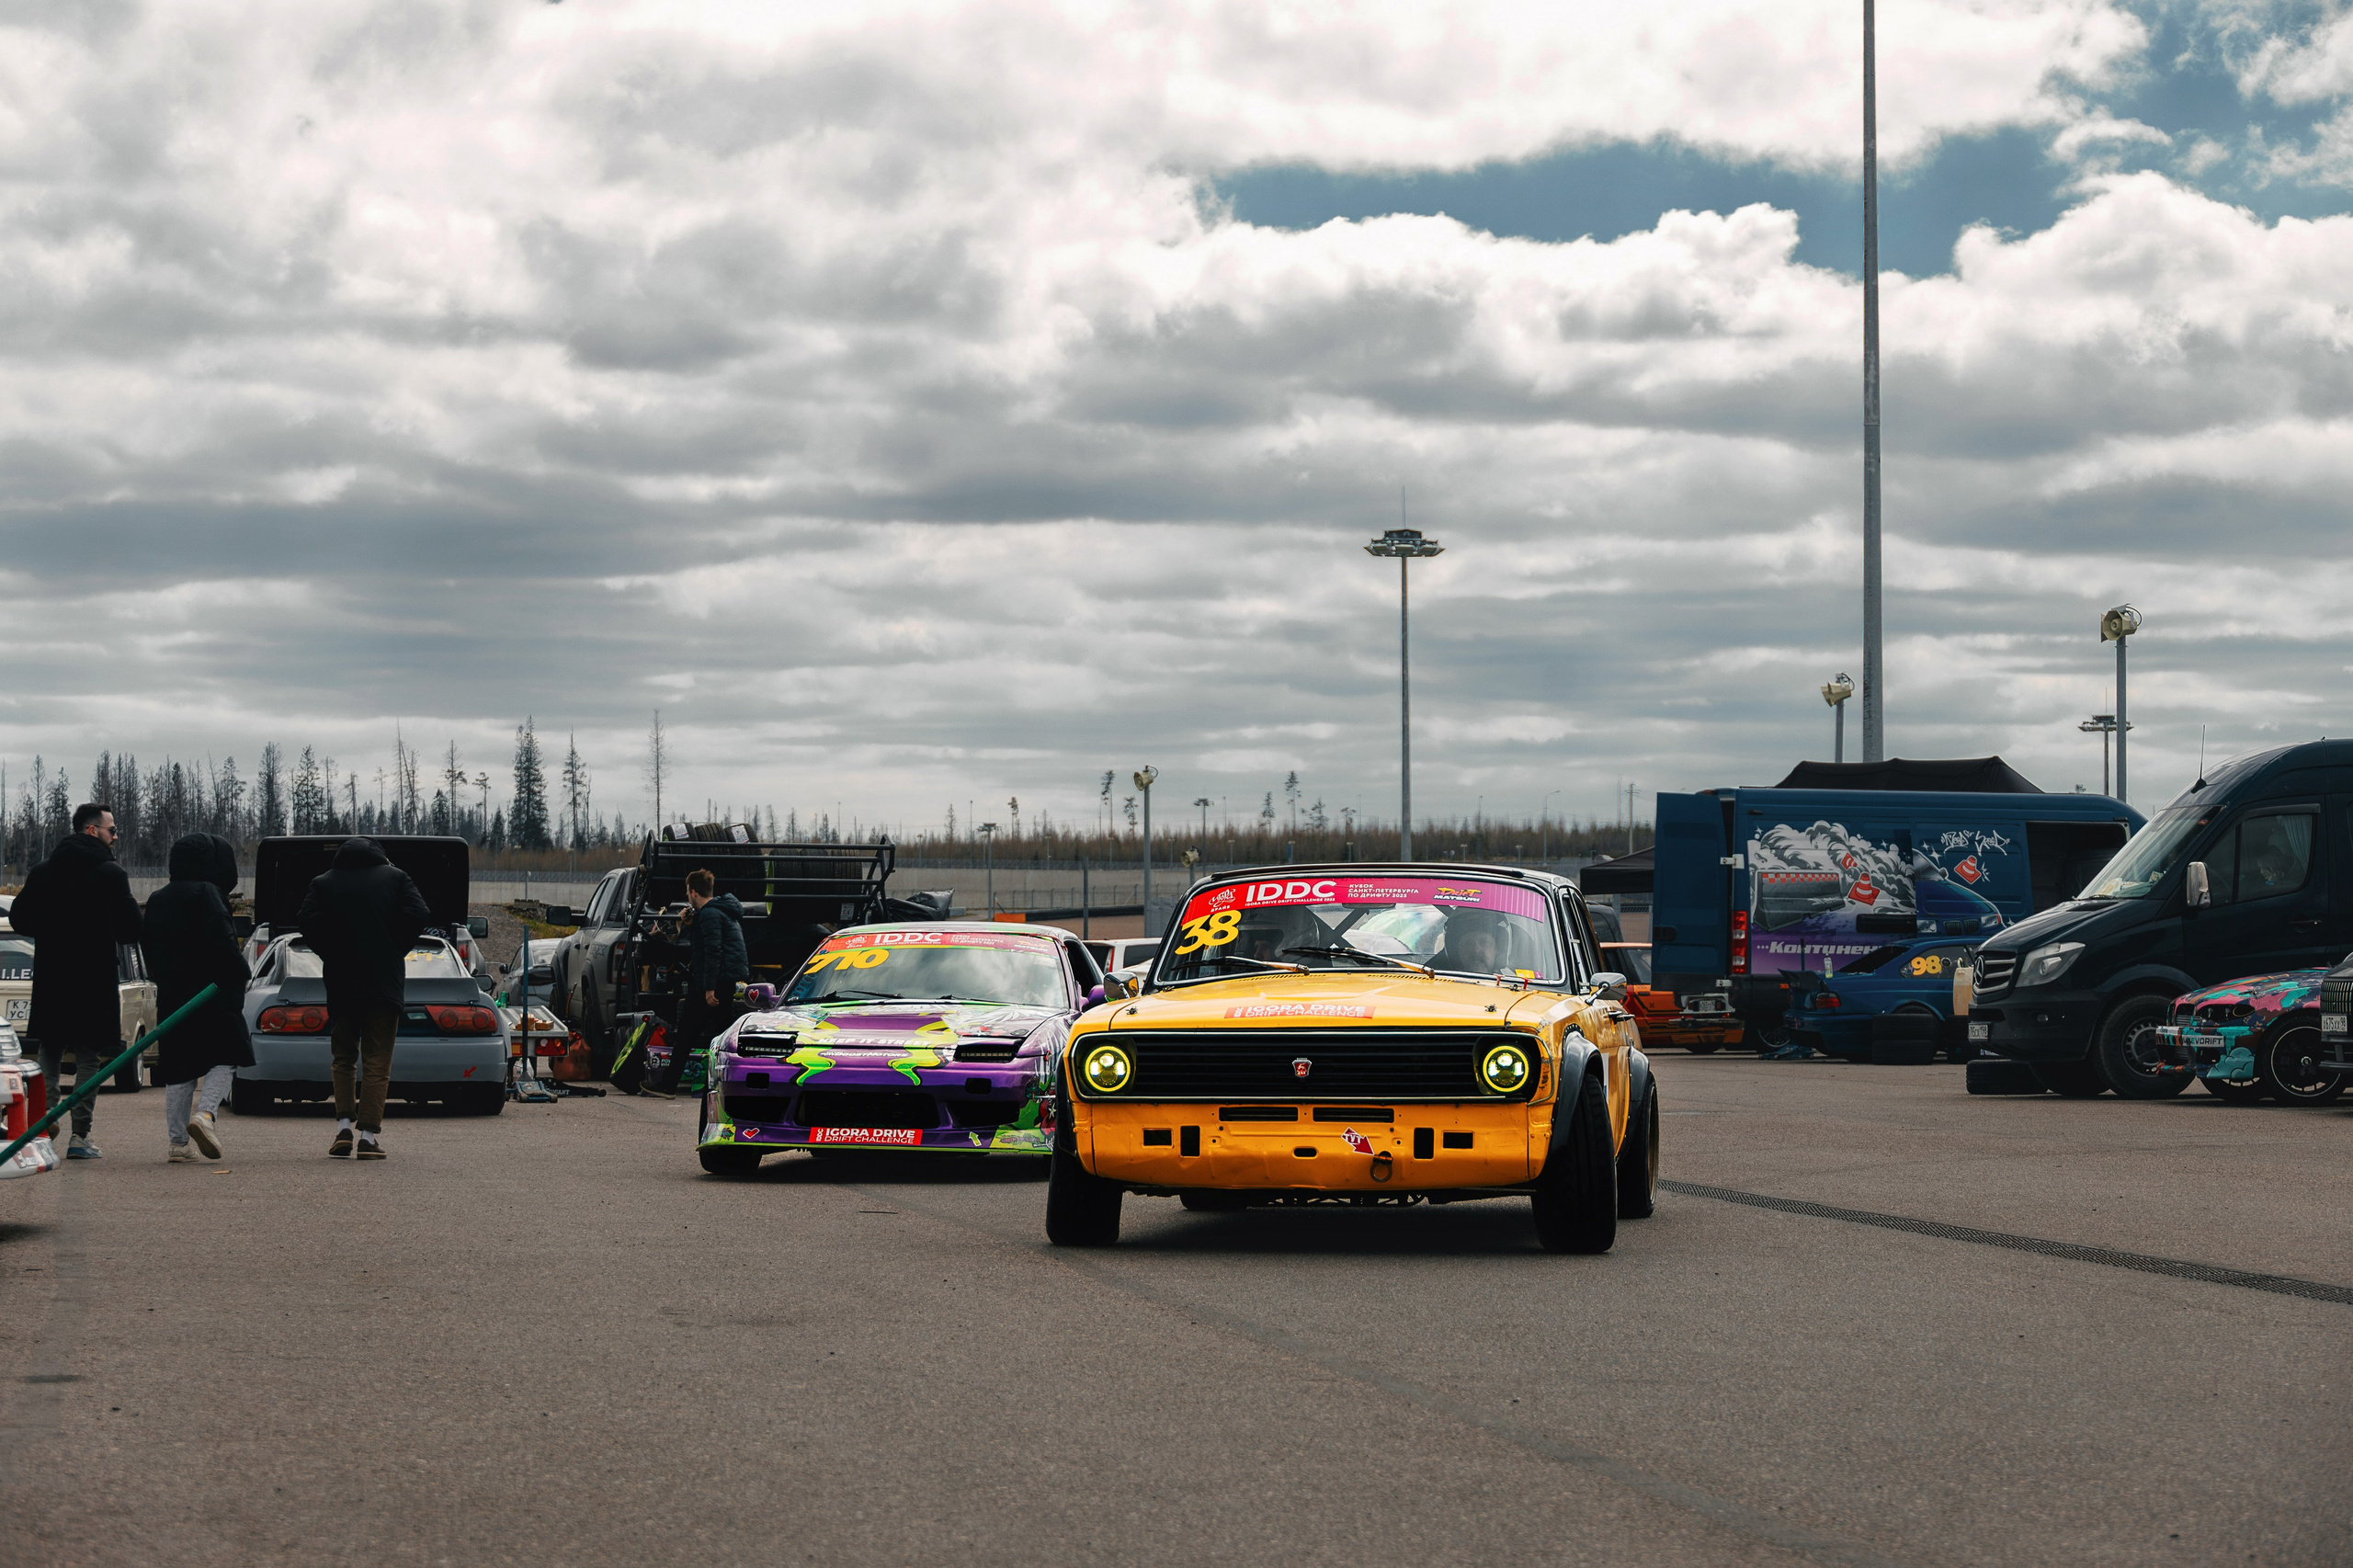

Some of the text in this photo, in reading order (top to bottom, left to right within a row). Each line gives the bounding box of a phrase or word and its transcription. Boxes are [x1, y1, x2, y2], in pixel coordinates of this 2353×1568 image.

[1245, 881, 1336, 902] IDDC
[1175, 910, 1242, 955] 38
[874, 933, 944, 944] IDDC
[1769, 941, 1881, 955] Континен
[803, 949, 889, 974] 710
[1911, 955, 1942, 976] 98
[1, 968, 34, 980] I.LE
[1285, 1009, 1365, 1017] CHALLENGE
[1310, 1004, 1366, 1012] DRIVE
[825, 1129, 915, 1138] IGORA DRIVE
[1344, 1133, 1361, 1144] ТУТ
[855, 1136, 915, 1144] CHALLENGE
